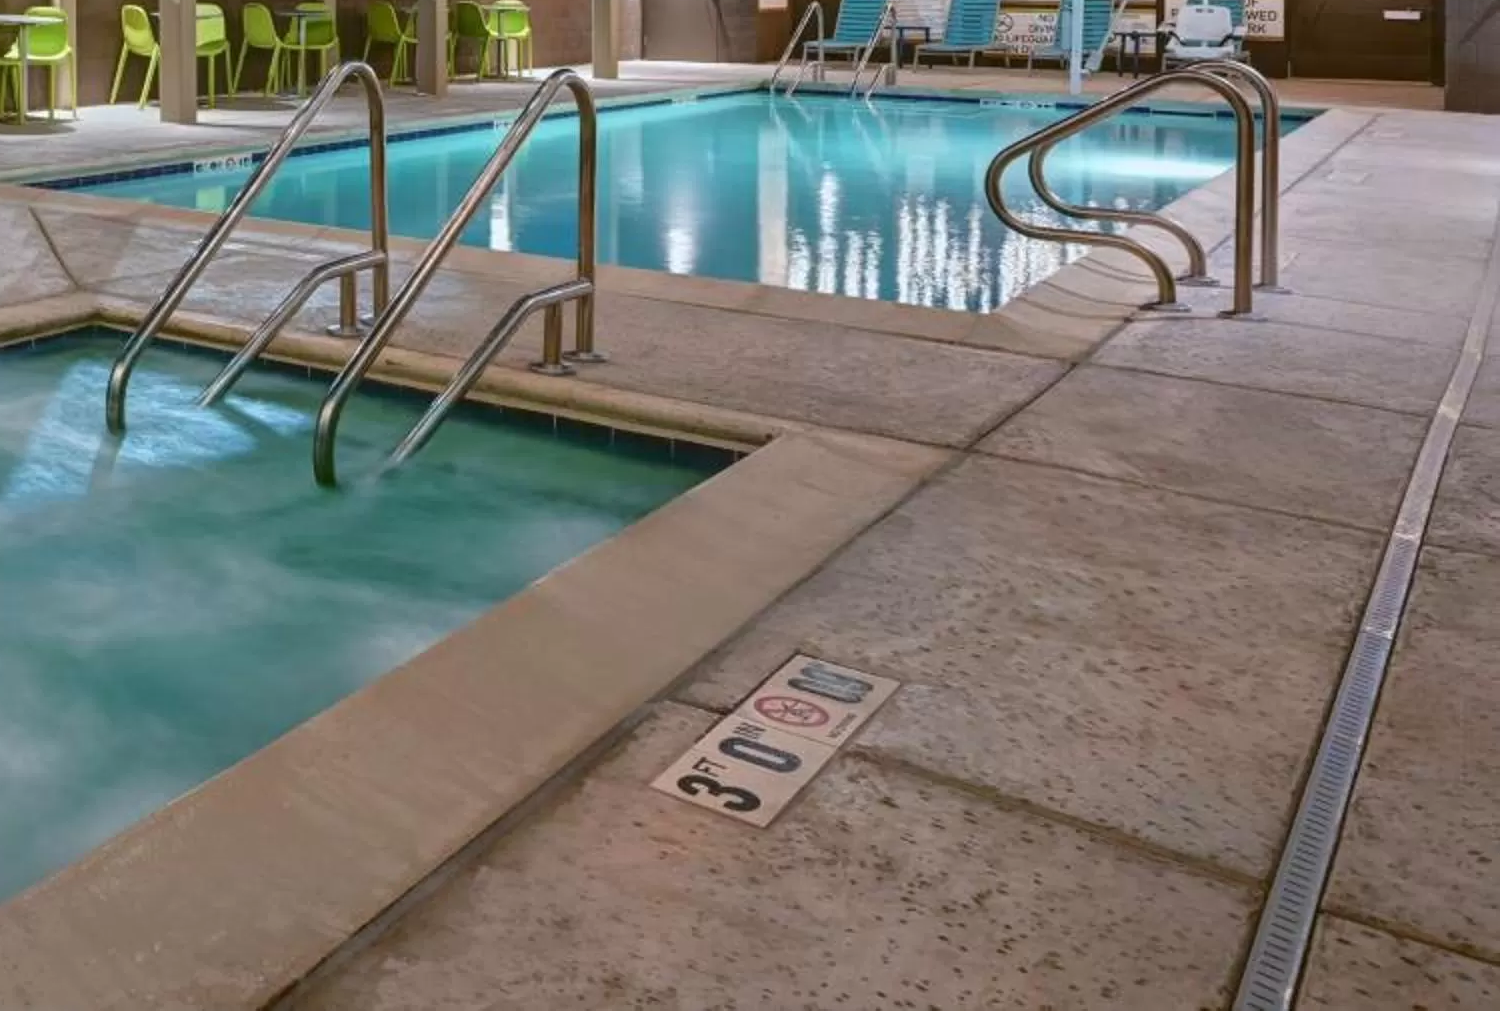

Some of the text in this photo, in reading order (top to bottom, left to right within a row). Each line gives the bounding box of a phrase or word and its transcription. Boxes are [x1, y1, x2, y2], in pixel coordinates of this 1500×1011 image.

[691, 756, 727, 778] FT
[718, 737, 802, 773] 0
[677, 774, 761, 812] 3
